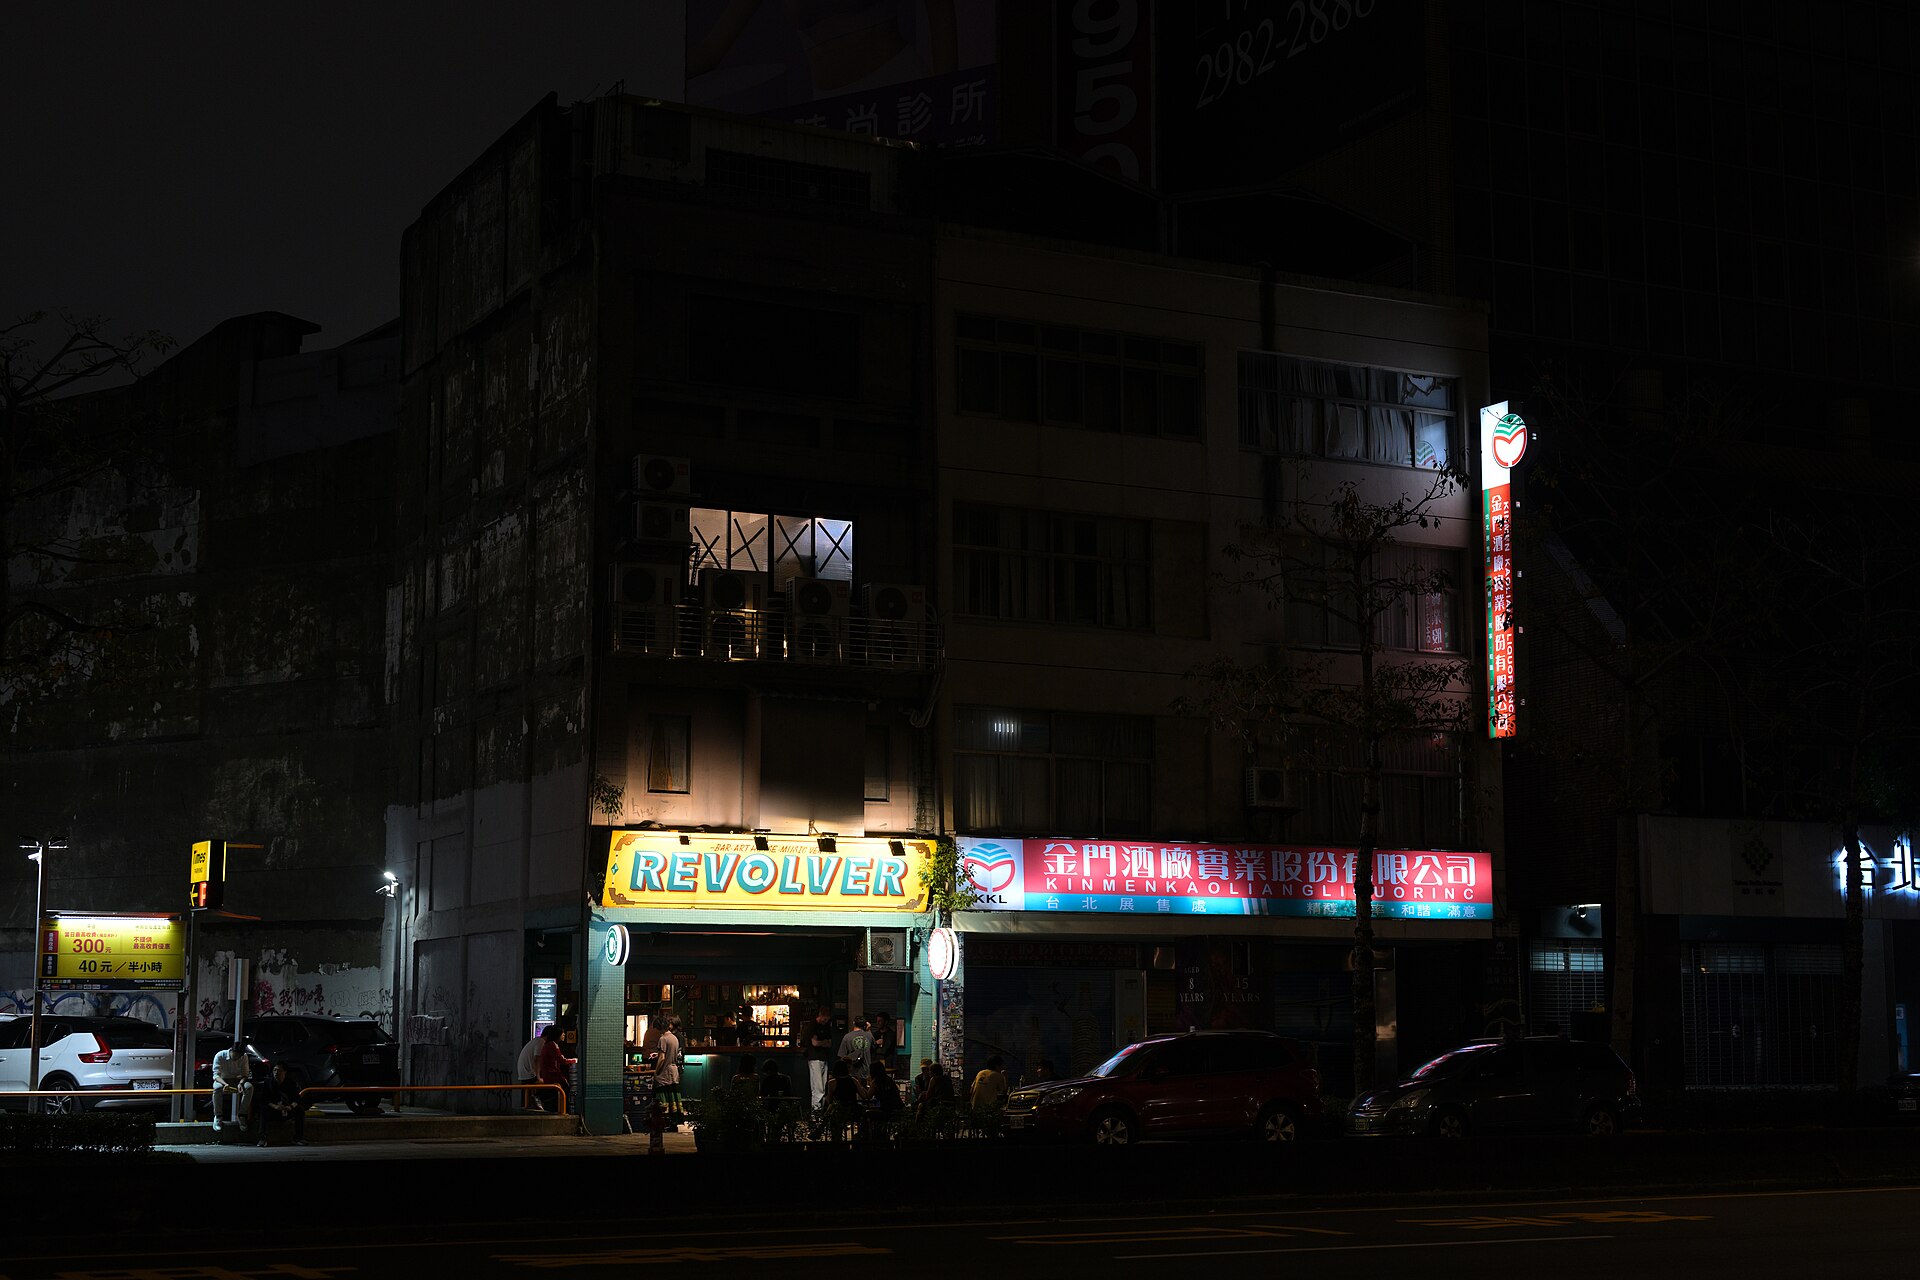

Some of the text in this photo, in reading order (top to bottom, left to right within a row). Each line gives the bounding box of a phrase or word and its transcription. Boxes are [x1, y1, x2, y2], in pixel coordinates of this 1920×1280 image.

[1506, 633, 1514, 684] LIQUOR
[750, 845, 778, 853] HSE
[630, 850, 909, 896] REVOLVER
[1046, 878, 1474, 900] KINMENKAOLIANGLIUORINC
[1046, 897, 1207, 913] 台北展售處
